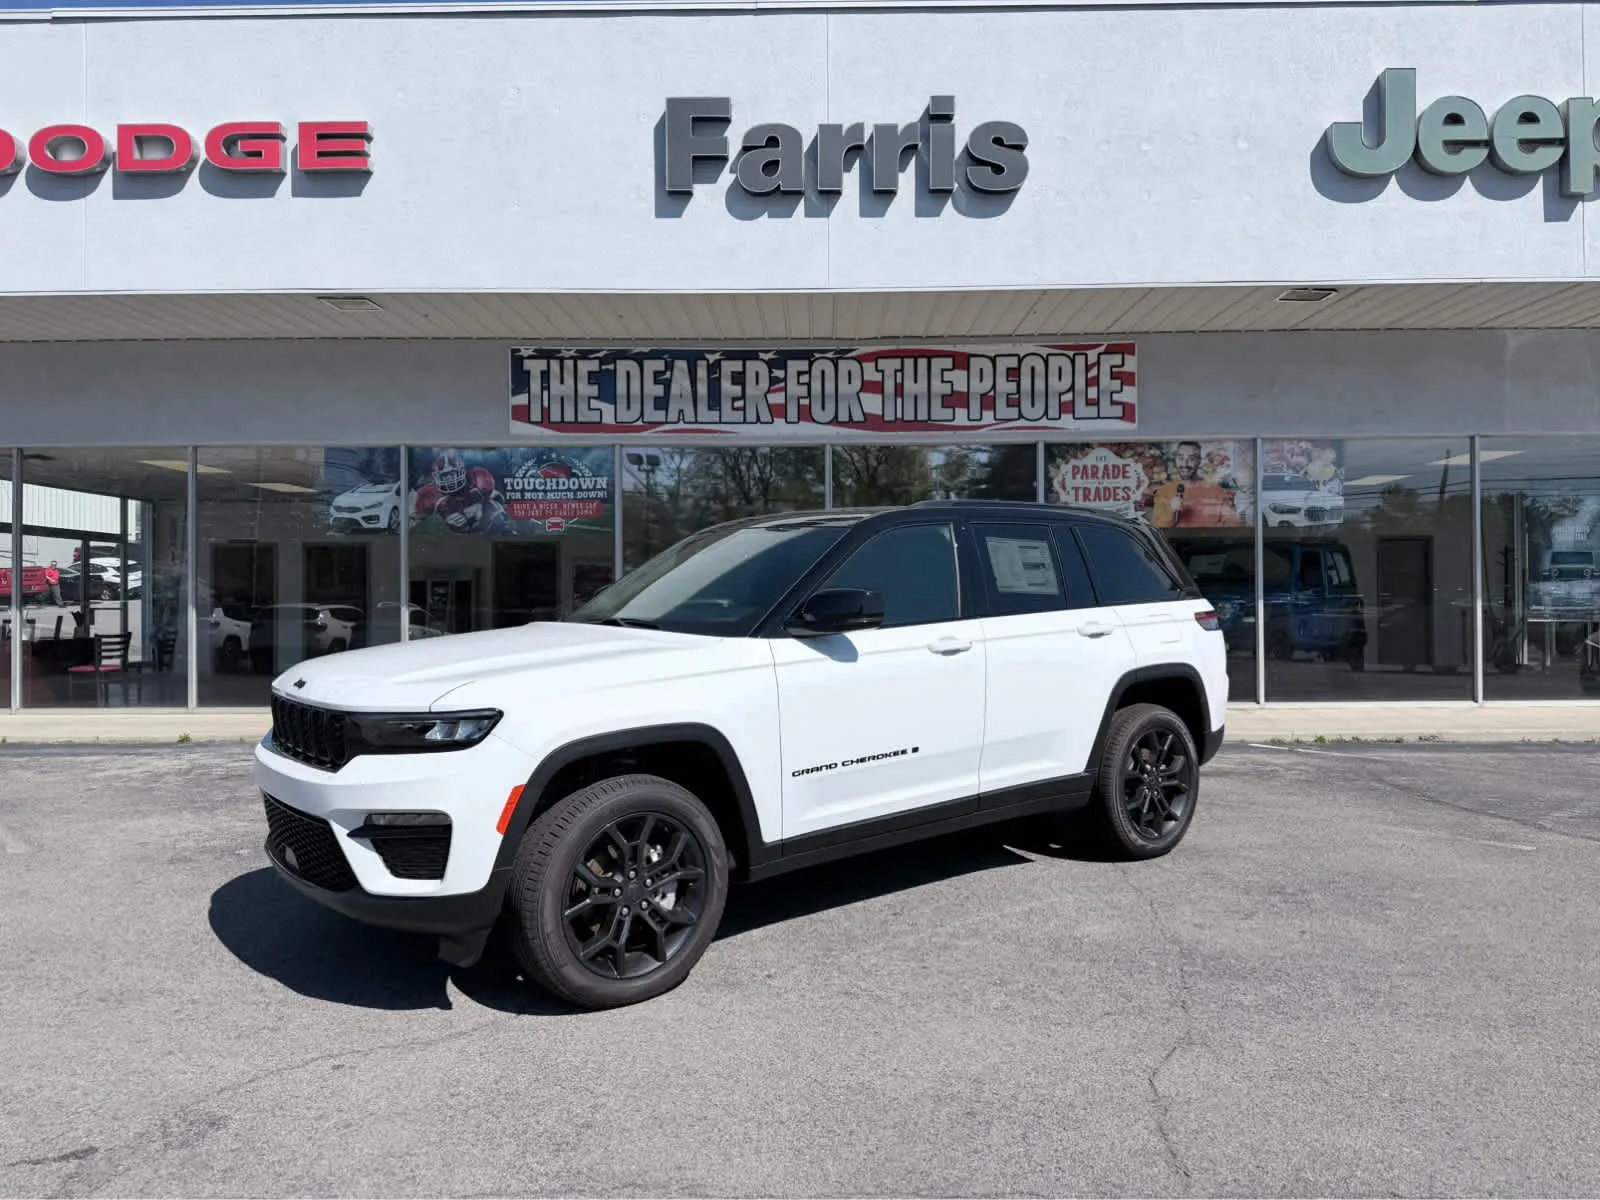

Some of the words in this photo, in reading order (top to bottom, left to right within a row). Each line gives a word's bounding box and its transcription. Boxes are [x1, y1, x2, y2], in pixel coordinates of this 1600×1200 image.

[0, 121, 373, 176] ODGE
[664, 95, 1030, 194] Farris
[523, 357, 600, 424] THE
[615, 357, 774, 424] DEALER
[785, 355, 866, 424] FOR
[875, 355, 955, 423] THE
[967, 352, 1125, 421] PEOPLE
[1071, 463, 1131, 480] PARADE
[504, 477, 608, 490] TOUCHDOWN
[506, 492, 521, 500] FOR
[524, 491, 544, 500] NOT
[547, 491, 574, 499] MUCH
[576, 490, 608, 498] DOWN!
[1071, 486, 1132, 504] TRADES
[791, 762, 838, 777] GRAND
[841, 748, 908, 767] CHEROKEE
